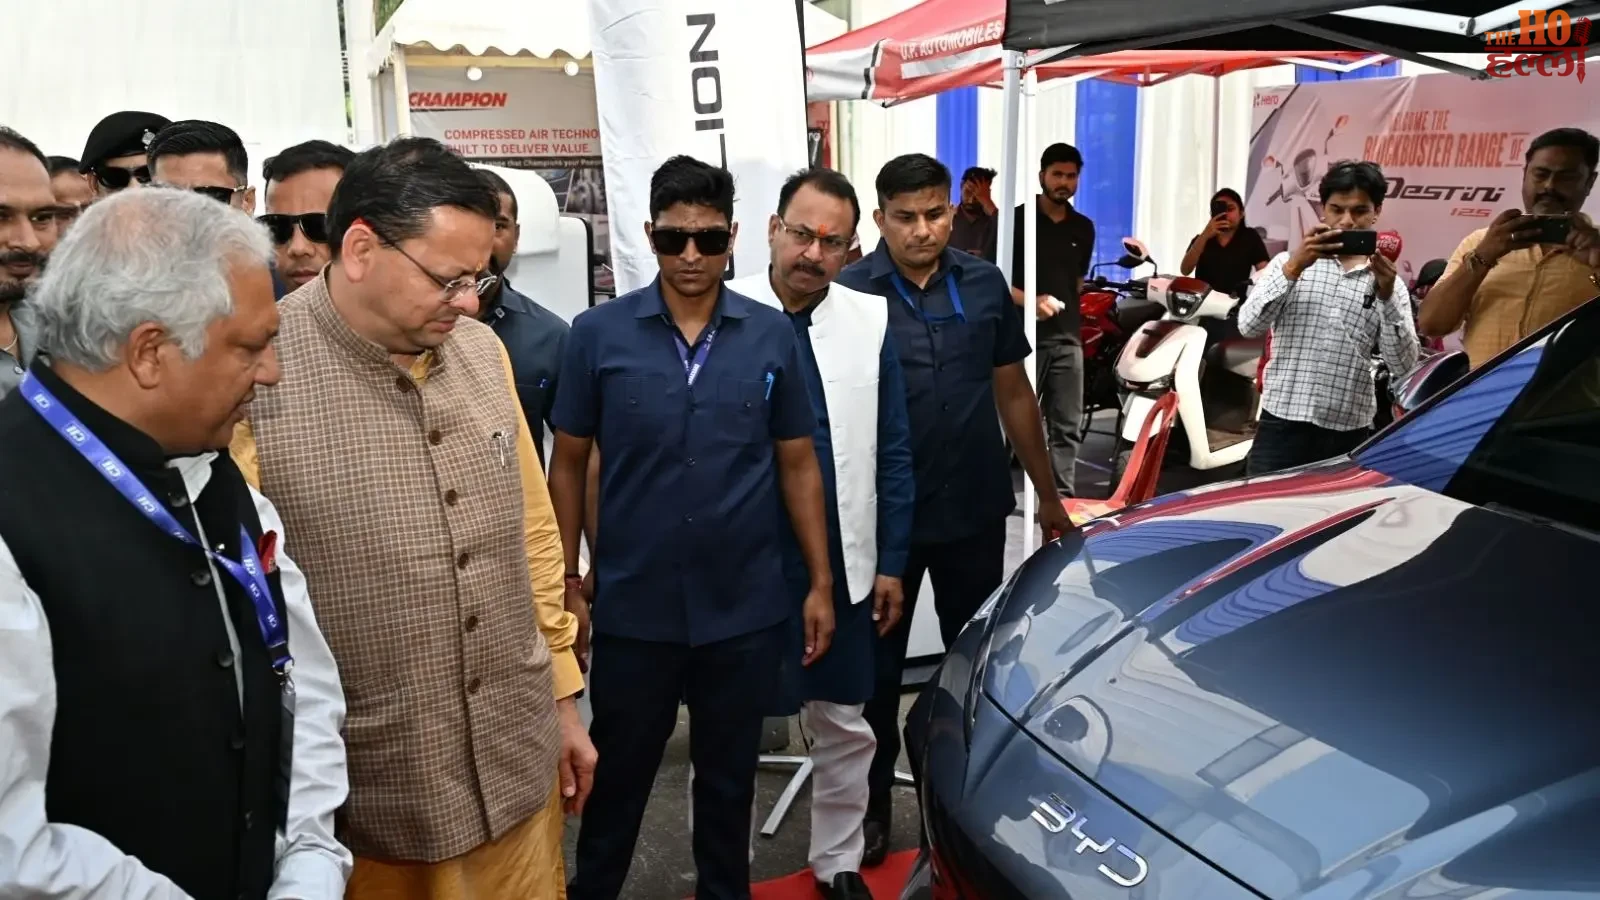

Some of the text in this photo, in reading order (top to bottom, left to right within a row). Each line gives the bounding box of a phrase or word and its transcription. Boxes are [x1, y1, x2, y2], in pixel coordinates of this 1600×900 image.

[920, 19, 1003, 57] AUTOMOBILES
[408, 91, 508, 109] CHAMPION
[1431, 109, 1450, 131] THE
[444, 129, 525, 140] COMPRESSED
[529, 129, 549, 140] AIR
[482, 144, 498, 154] TO
[501, 143, 549, 154] DELIVER
[1455, 131, 1508, 168] RANGE
[1510, 138, 1525, 161] OF
[1450, 207, 1492, 217] 125
[1030, 793, 1148, 887] BYD
